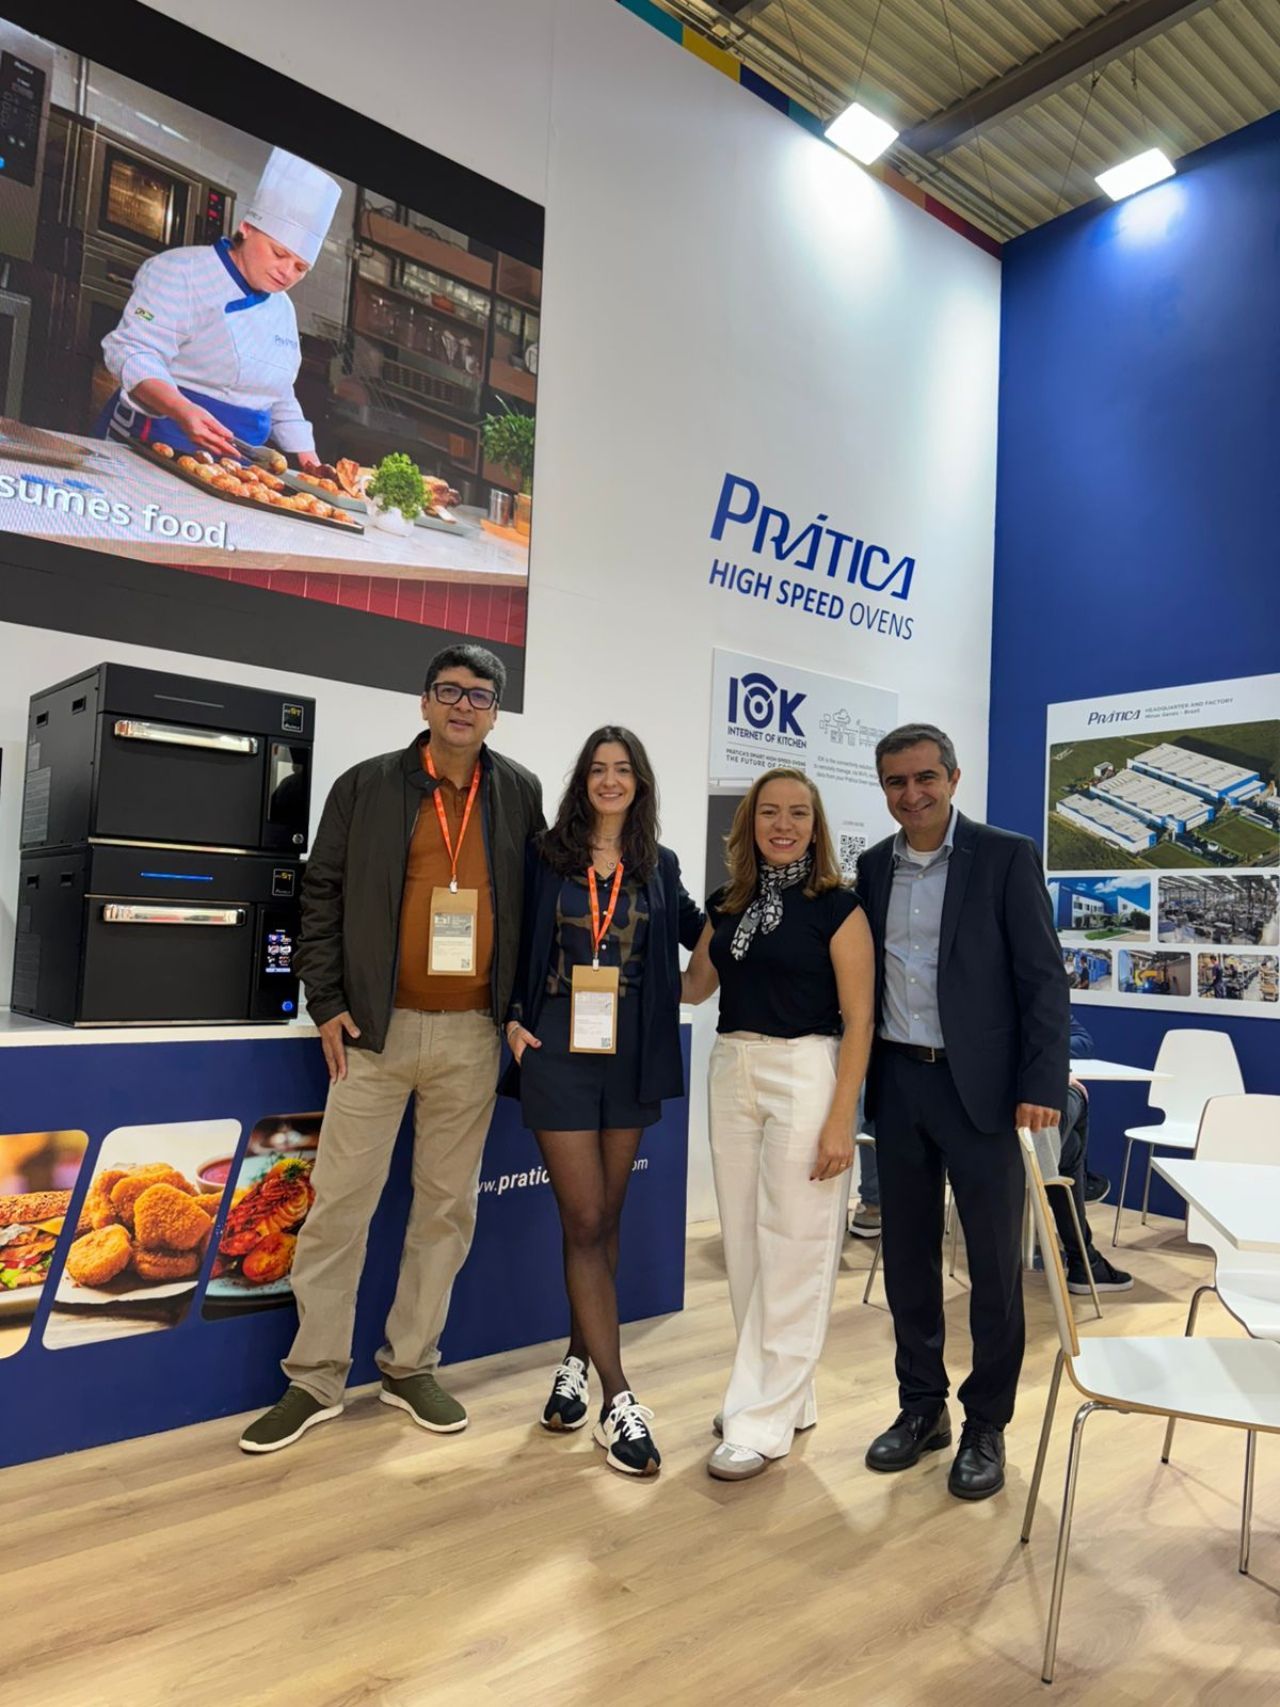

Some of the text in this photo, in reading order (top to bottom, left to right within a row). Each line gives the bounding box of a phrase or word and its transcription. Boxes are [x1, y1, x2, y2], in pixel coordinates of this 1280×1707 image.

[142, 504, 236, 552] food.
[710, 472, 916, 600] PRÁTICA
[709, 558, 914, 640] HIGH SPEED OVENS
[1205, 697, 1233, 705] FACTORY
[1087, 709, 1141, 726] PRÁTICA
[727, 725, 807, 749] INTERNET OF KITCHEN
[726, 754, 739, 763] THE
[741, 757, 766, 768] FUTURE
